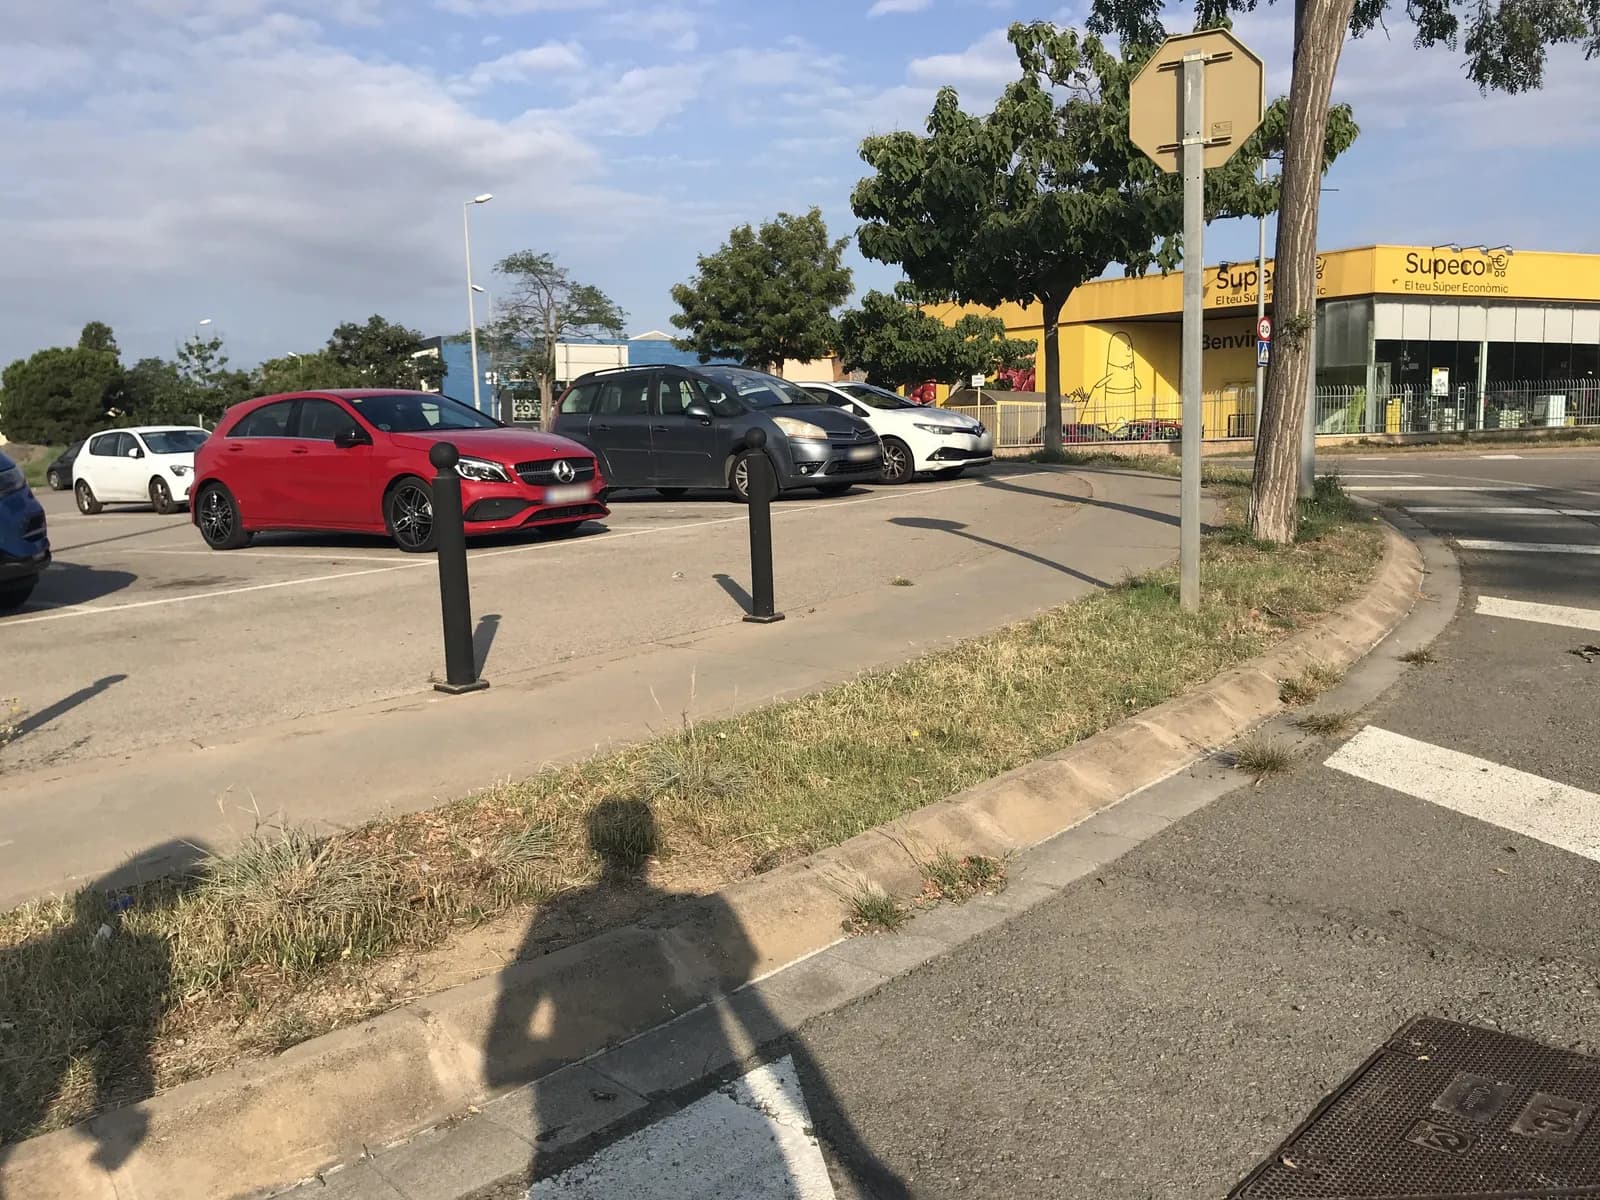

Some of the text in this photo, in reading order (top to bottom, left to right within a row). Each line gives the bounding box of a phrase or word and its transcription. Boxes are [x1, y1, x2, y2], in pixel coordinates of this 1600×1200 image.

[1405, 252, 1485, 280] Supeco
[1216, 268, 1274, 292] Supe
[1405, 280, 1509, 294] El teu Súper Econòmic
[1215, 292, 1273, 306] El teu Súer
[1261, 324, 1270, 334] 30
